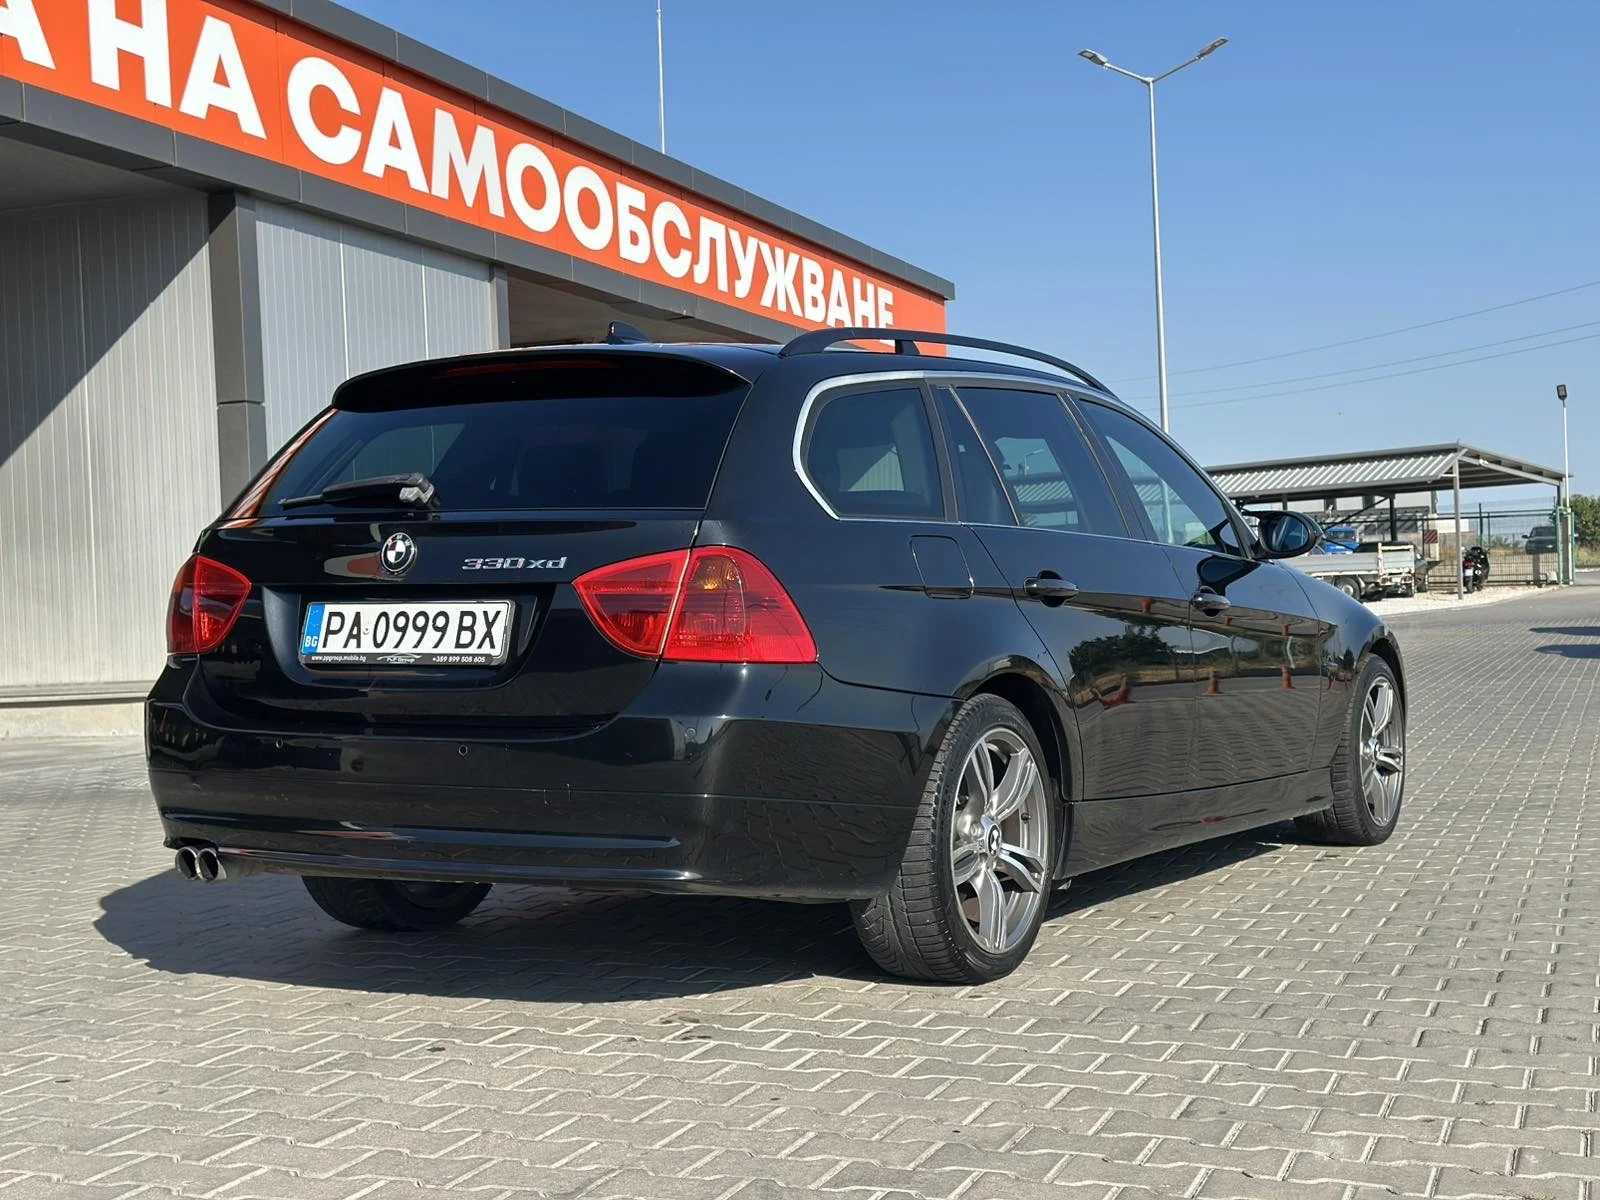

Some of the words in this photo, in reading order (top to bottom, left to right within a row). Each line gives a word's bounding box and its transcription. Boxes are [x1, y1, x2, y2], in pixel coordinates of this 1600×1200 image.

[88, 0, 267, 139] НА
[287, 57, 895, 346] САМООБСЛУЖВАНЕ
[462, 556, 567, 570] 330xd
[304, 635, 318, 648] BG
[372, 610, 450, 649] 0999
